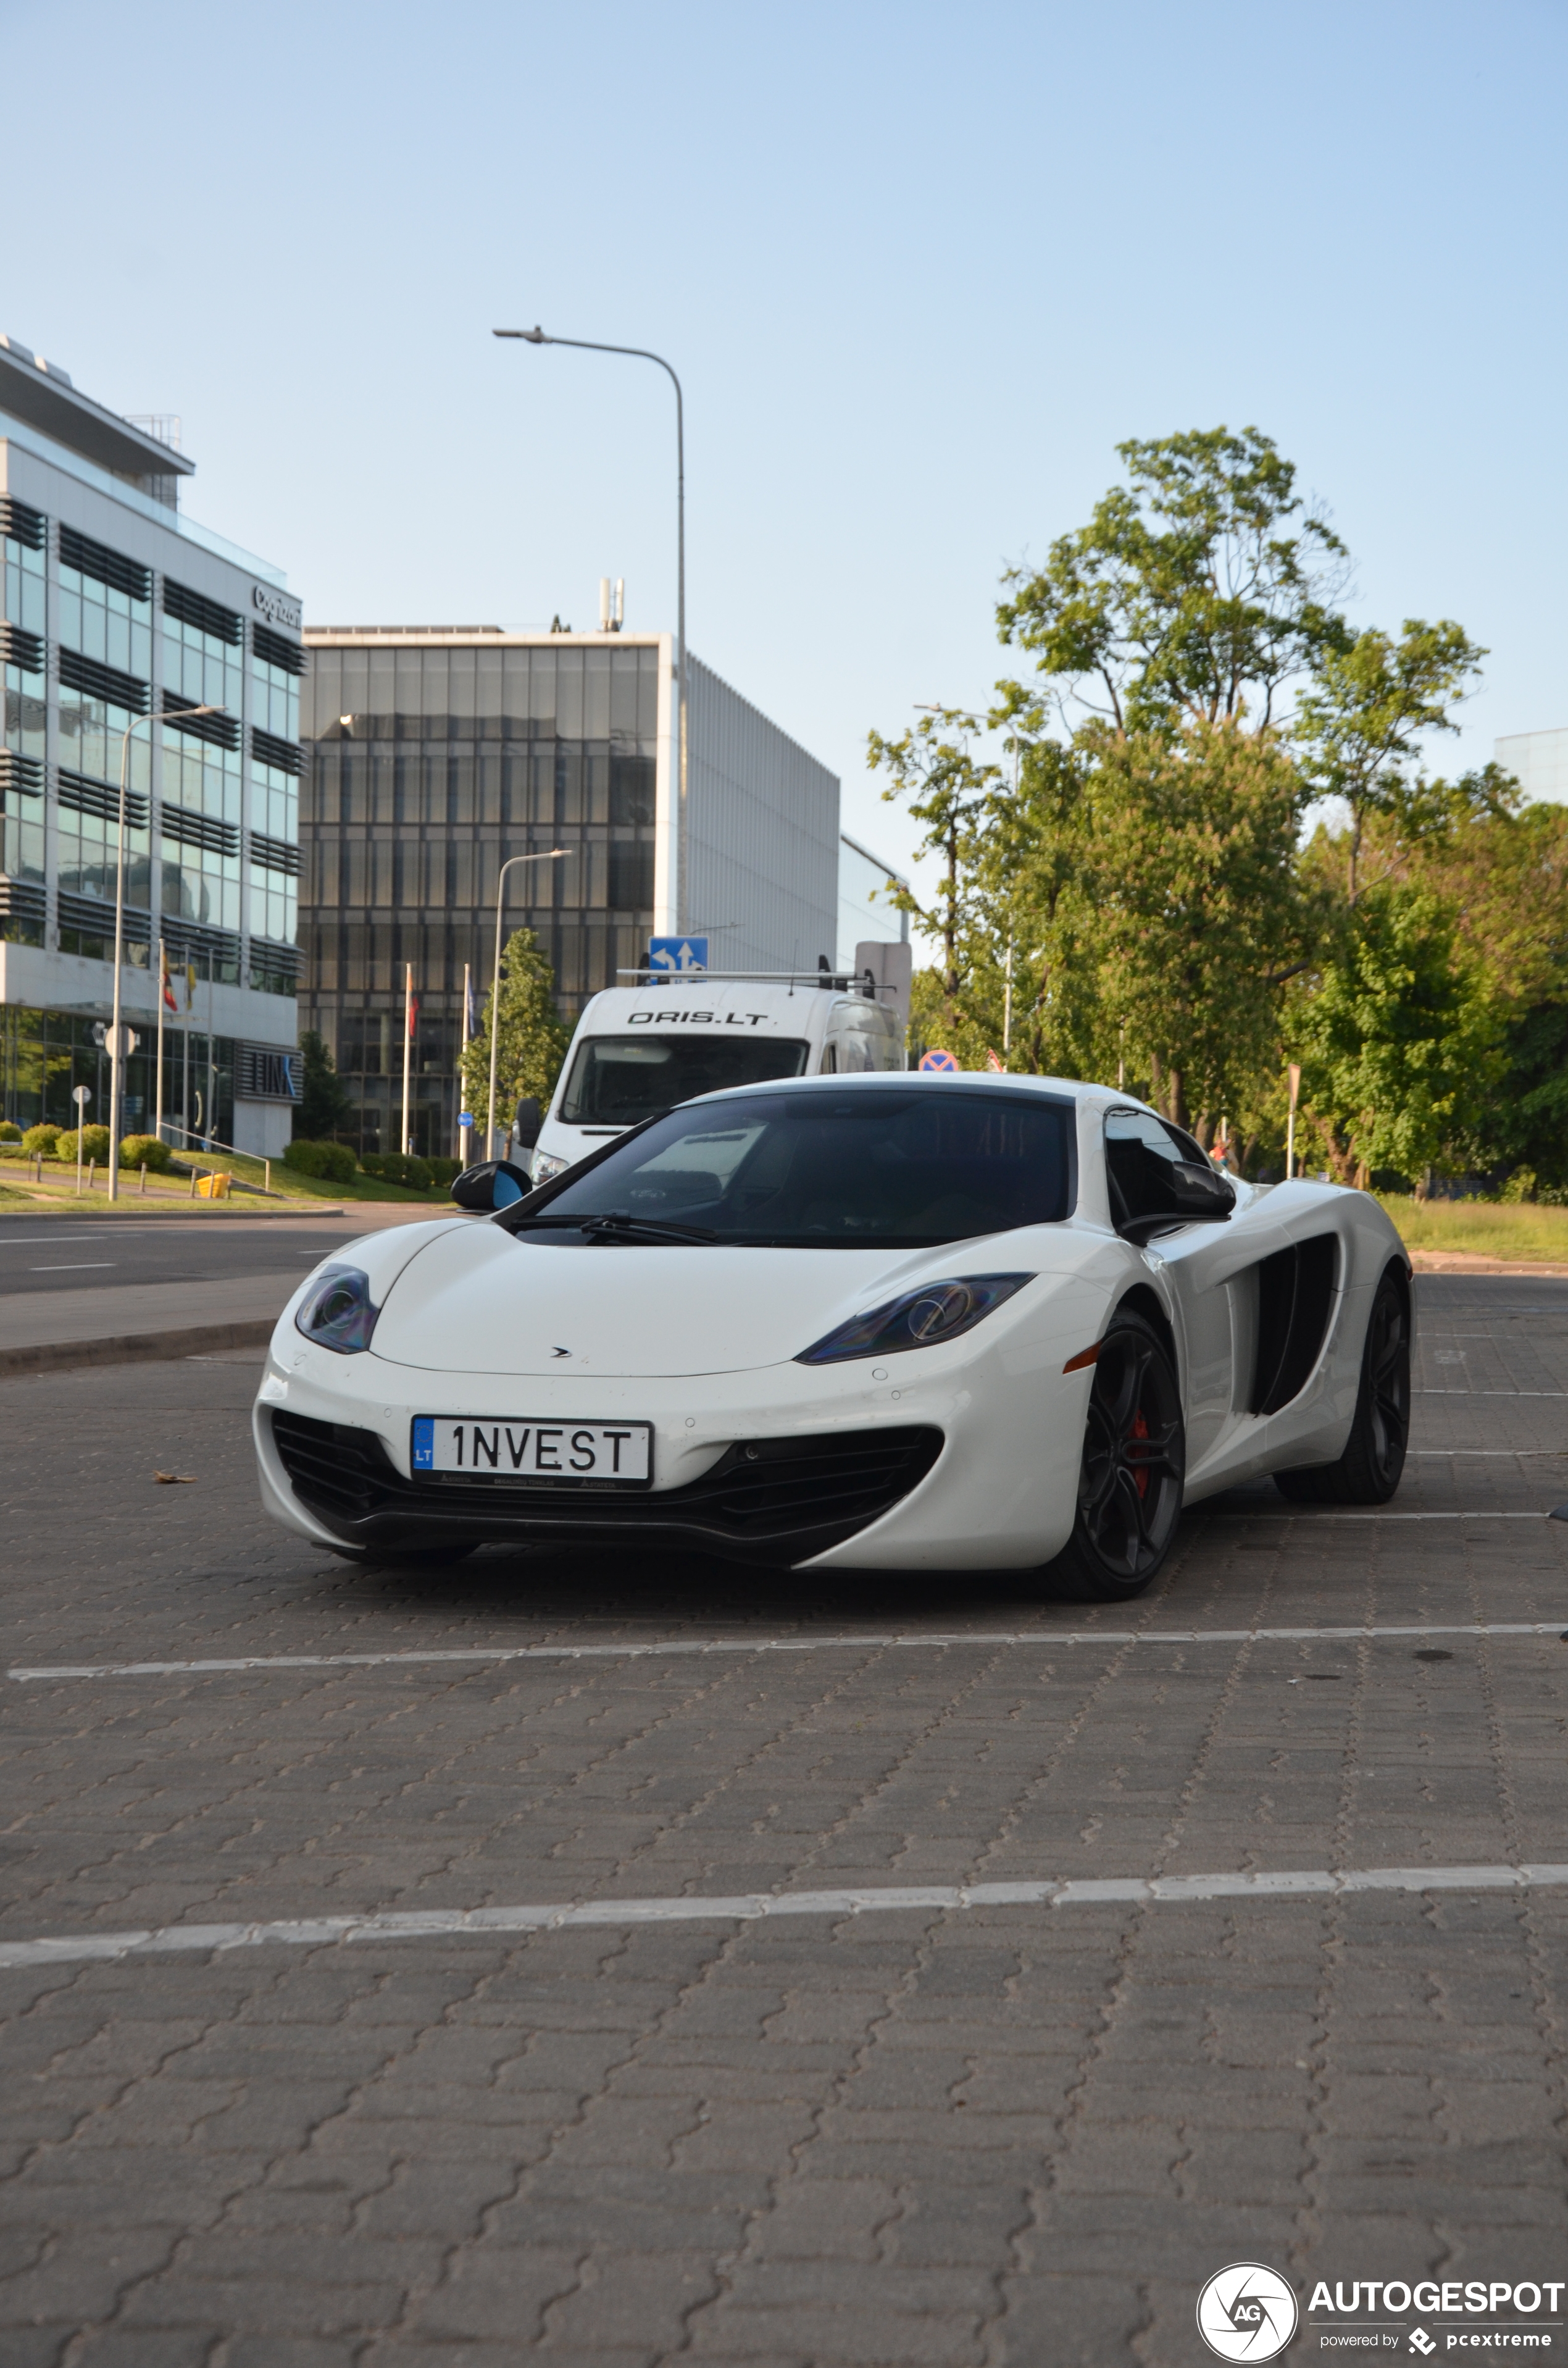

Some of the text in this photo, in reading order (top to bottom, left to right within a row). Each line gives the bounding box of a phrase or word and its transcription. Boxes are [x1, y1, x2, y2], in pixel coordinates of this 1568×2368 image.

[627, 1011, 768, 1026] ORIS.LT
[415, 1450, 432, 1462] LT
[453, 1425, 631, 1472] 1NVEST
